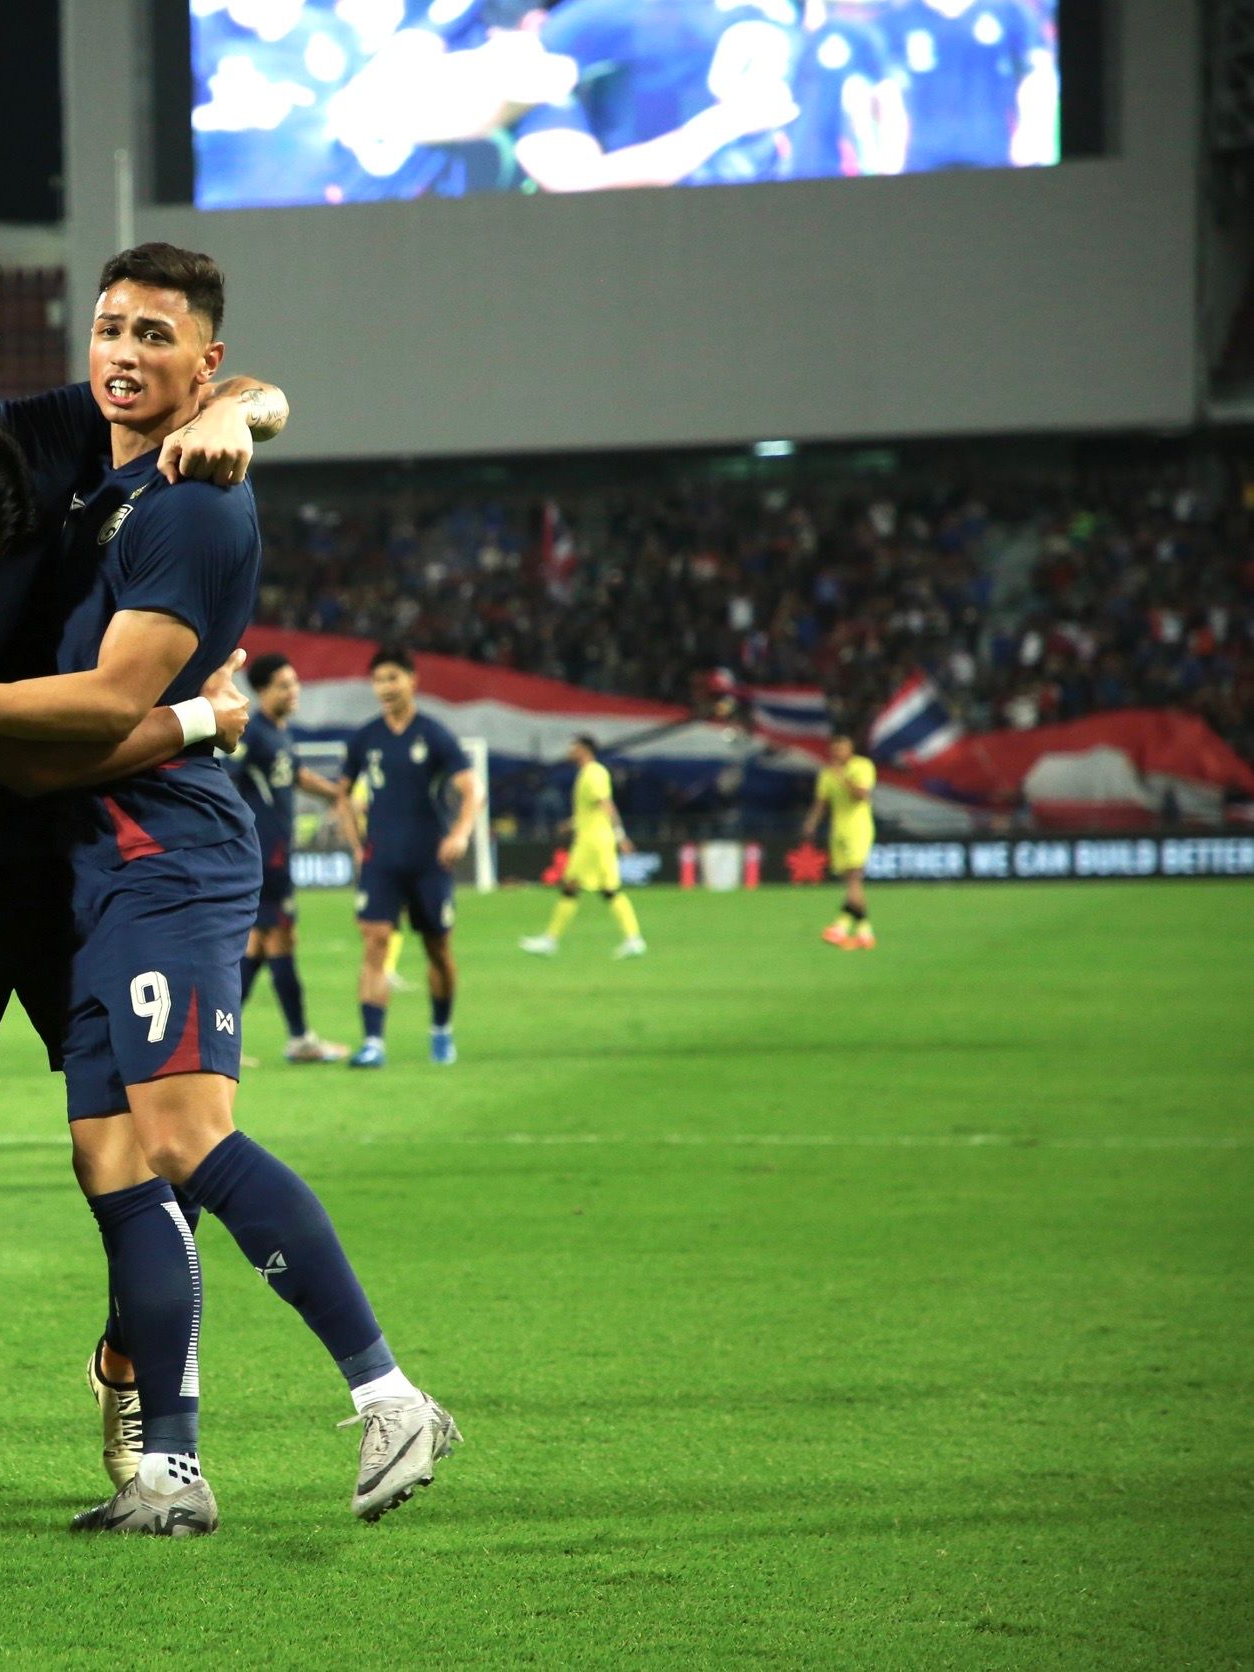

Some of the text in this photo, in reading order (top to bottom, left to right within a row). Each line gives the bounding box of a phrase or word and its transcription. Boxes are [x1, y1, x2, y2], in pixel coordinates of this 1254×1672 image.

[290, 851, 352, 886] UILD
[864, 838, 1254, 878] GETHER WE CAN BUILD BETTER
[130, 971, 171, 1043] 9
